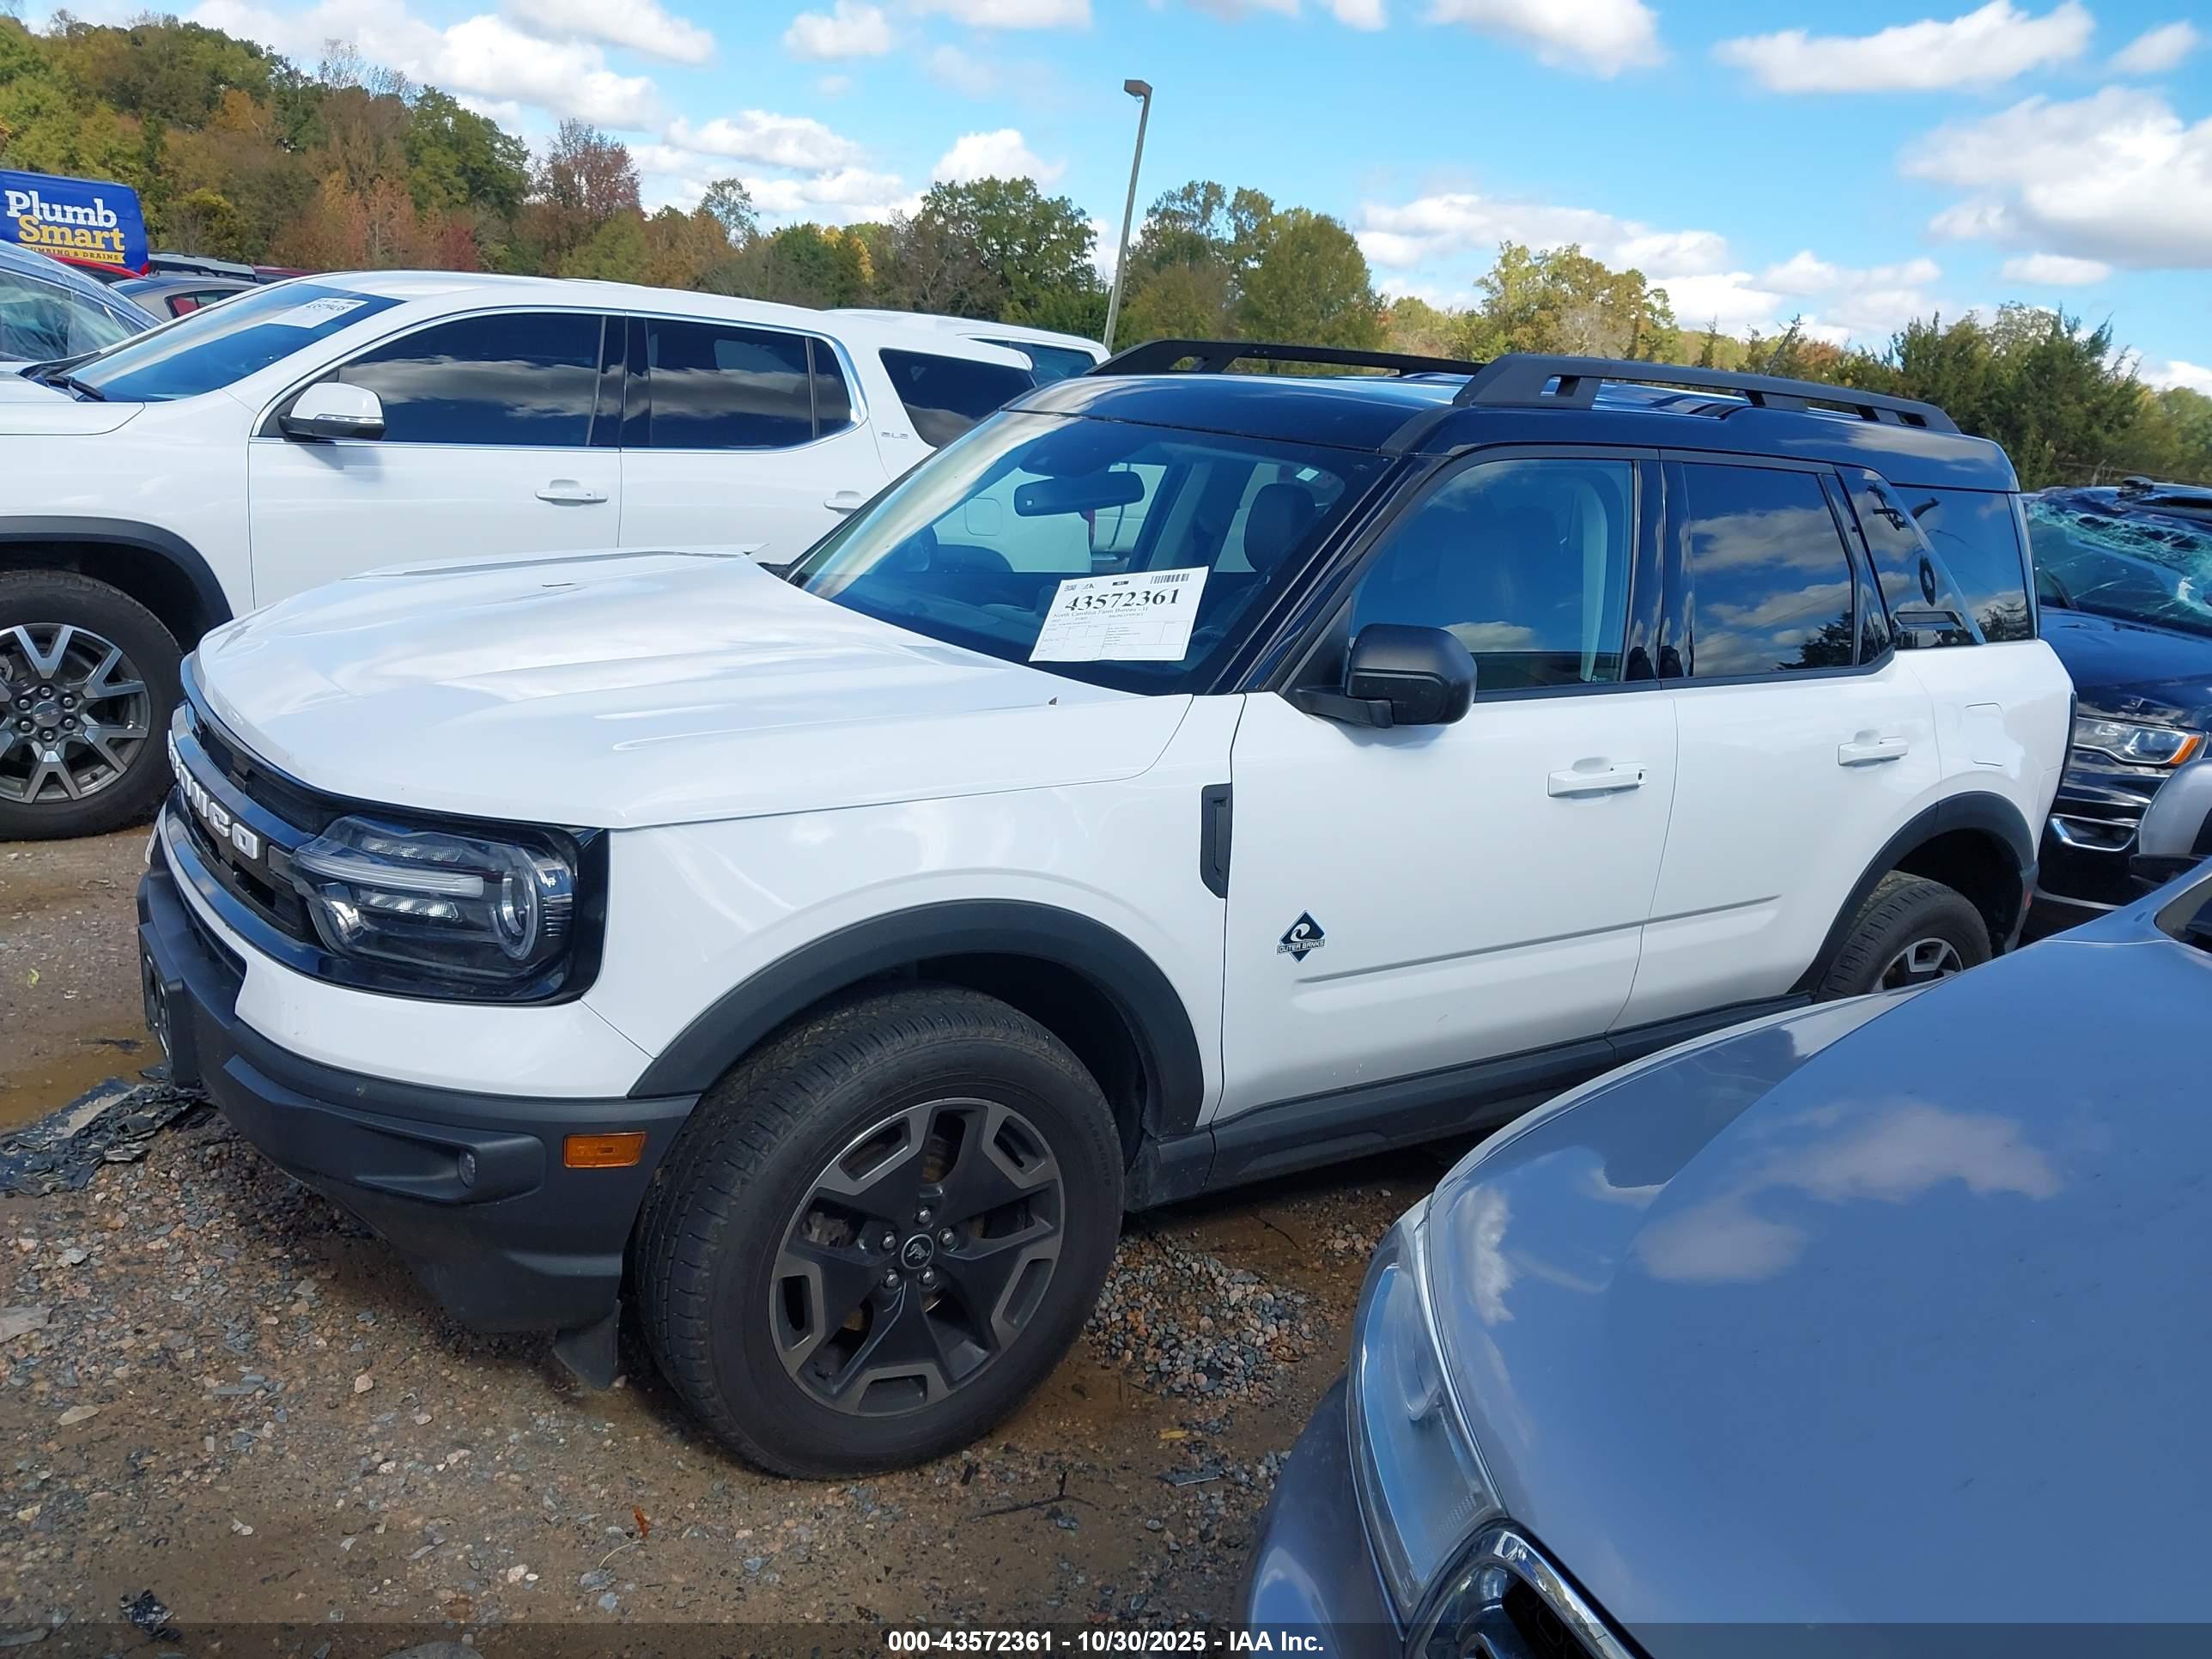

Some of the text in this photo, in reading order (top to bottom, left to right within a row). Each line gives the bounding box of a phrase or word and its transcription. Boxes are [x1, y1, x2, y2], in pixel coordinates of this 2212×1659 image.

[4, 190, 118, 228] Plumb
[18, 215, 125, 251] Smart
[31, 246, 70, 257] UMBING
[82, 252, 119, 261] DRAINS
[1065, 588, 1180, 611] 43572361
[1279, 940, 1325, 953] OUTER BANKS
